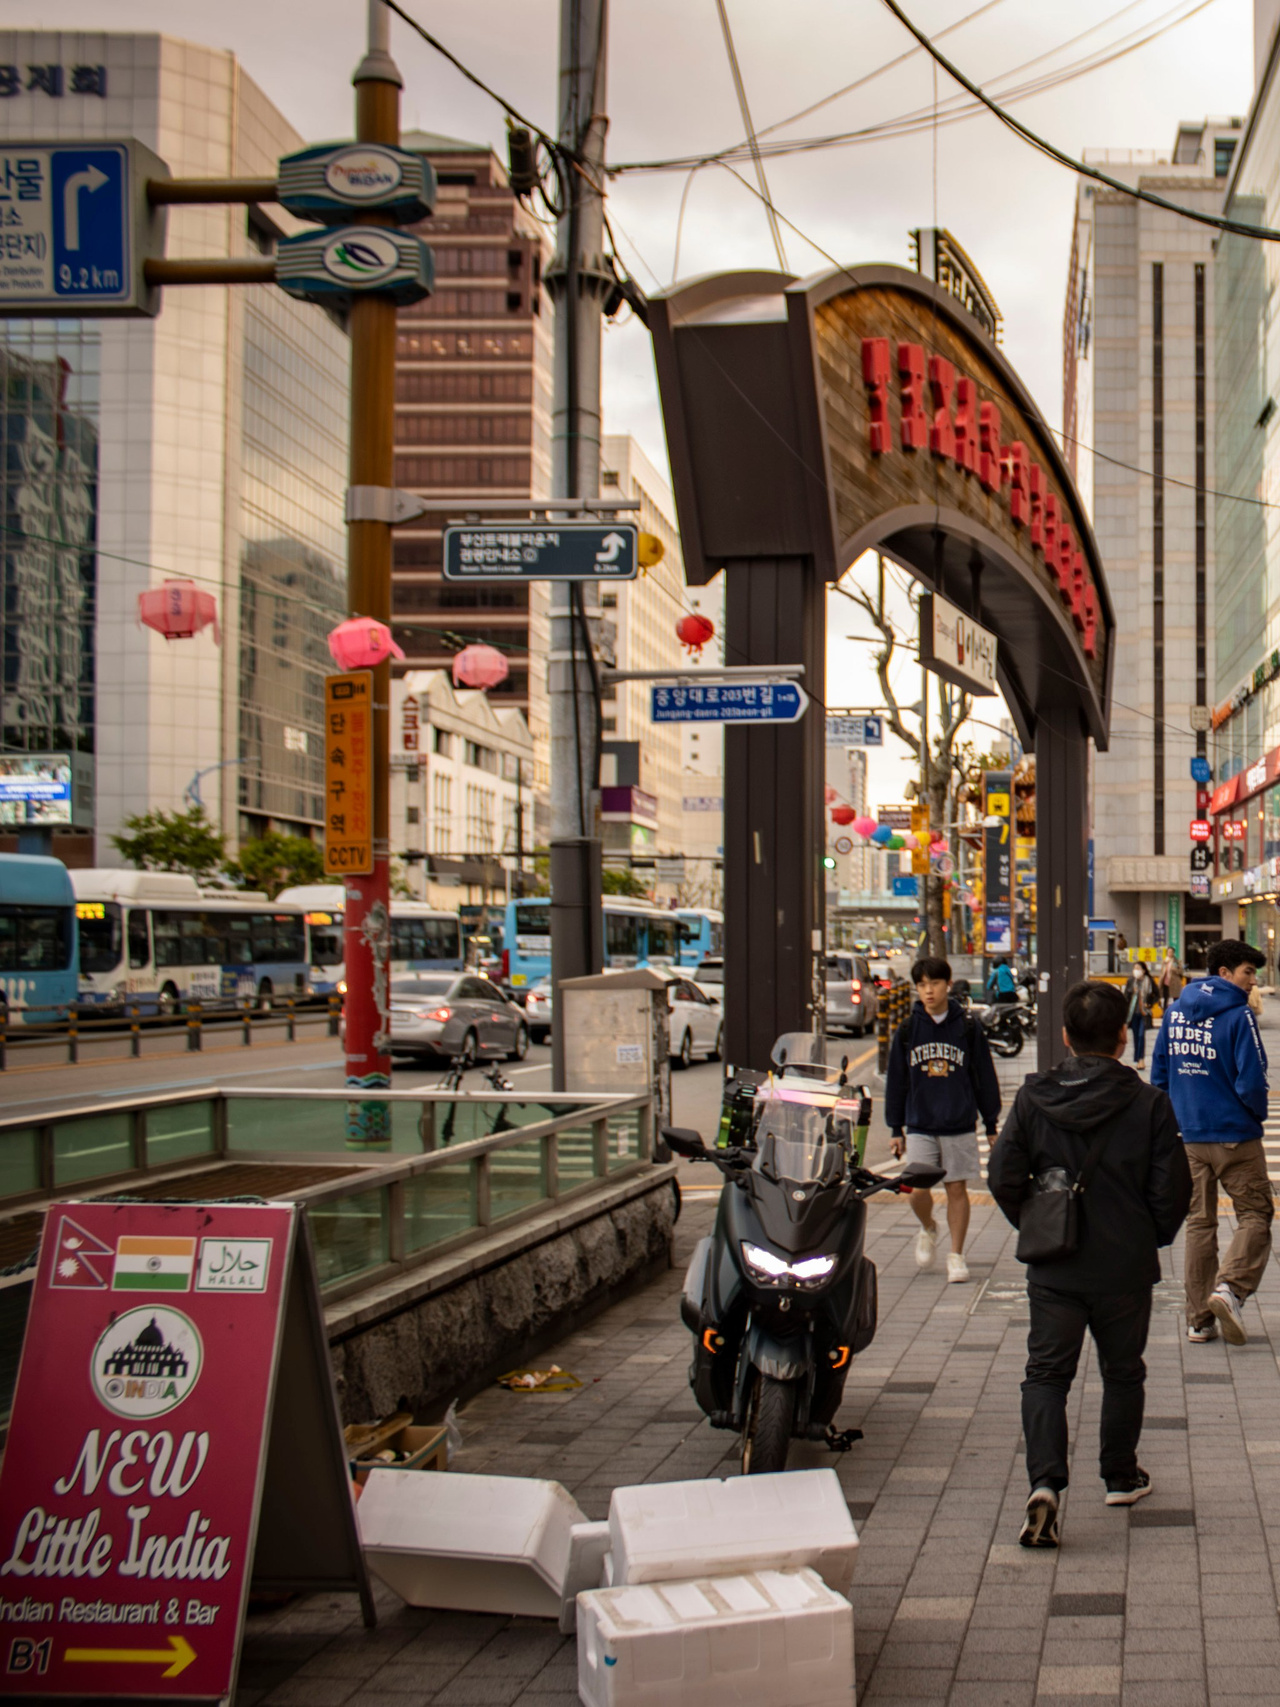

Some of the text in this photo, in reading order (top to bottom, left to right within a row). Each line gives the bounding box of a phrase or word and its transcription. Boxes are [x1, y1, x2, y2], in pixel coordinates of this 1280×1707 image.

[328, 846, 366, 866] CCTV
[1168, 1026, 1213, 1045] UNDER
[910, 1042, 965, 1067] ATHENEUM
[207, 1273, 257, 1287] HALAL
[124, 1375, 179, 1401] INDIA
[54, 1428, 210, 1498] NEW
[2, 1504, 231, 1581] Little India
[58, 1597, 220, 1627] Restaurant & Bar
[8, 1636, 54, 1675] B1
